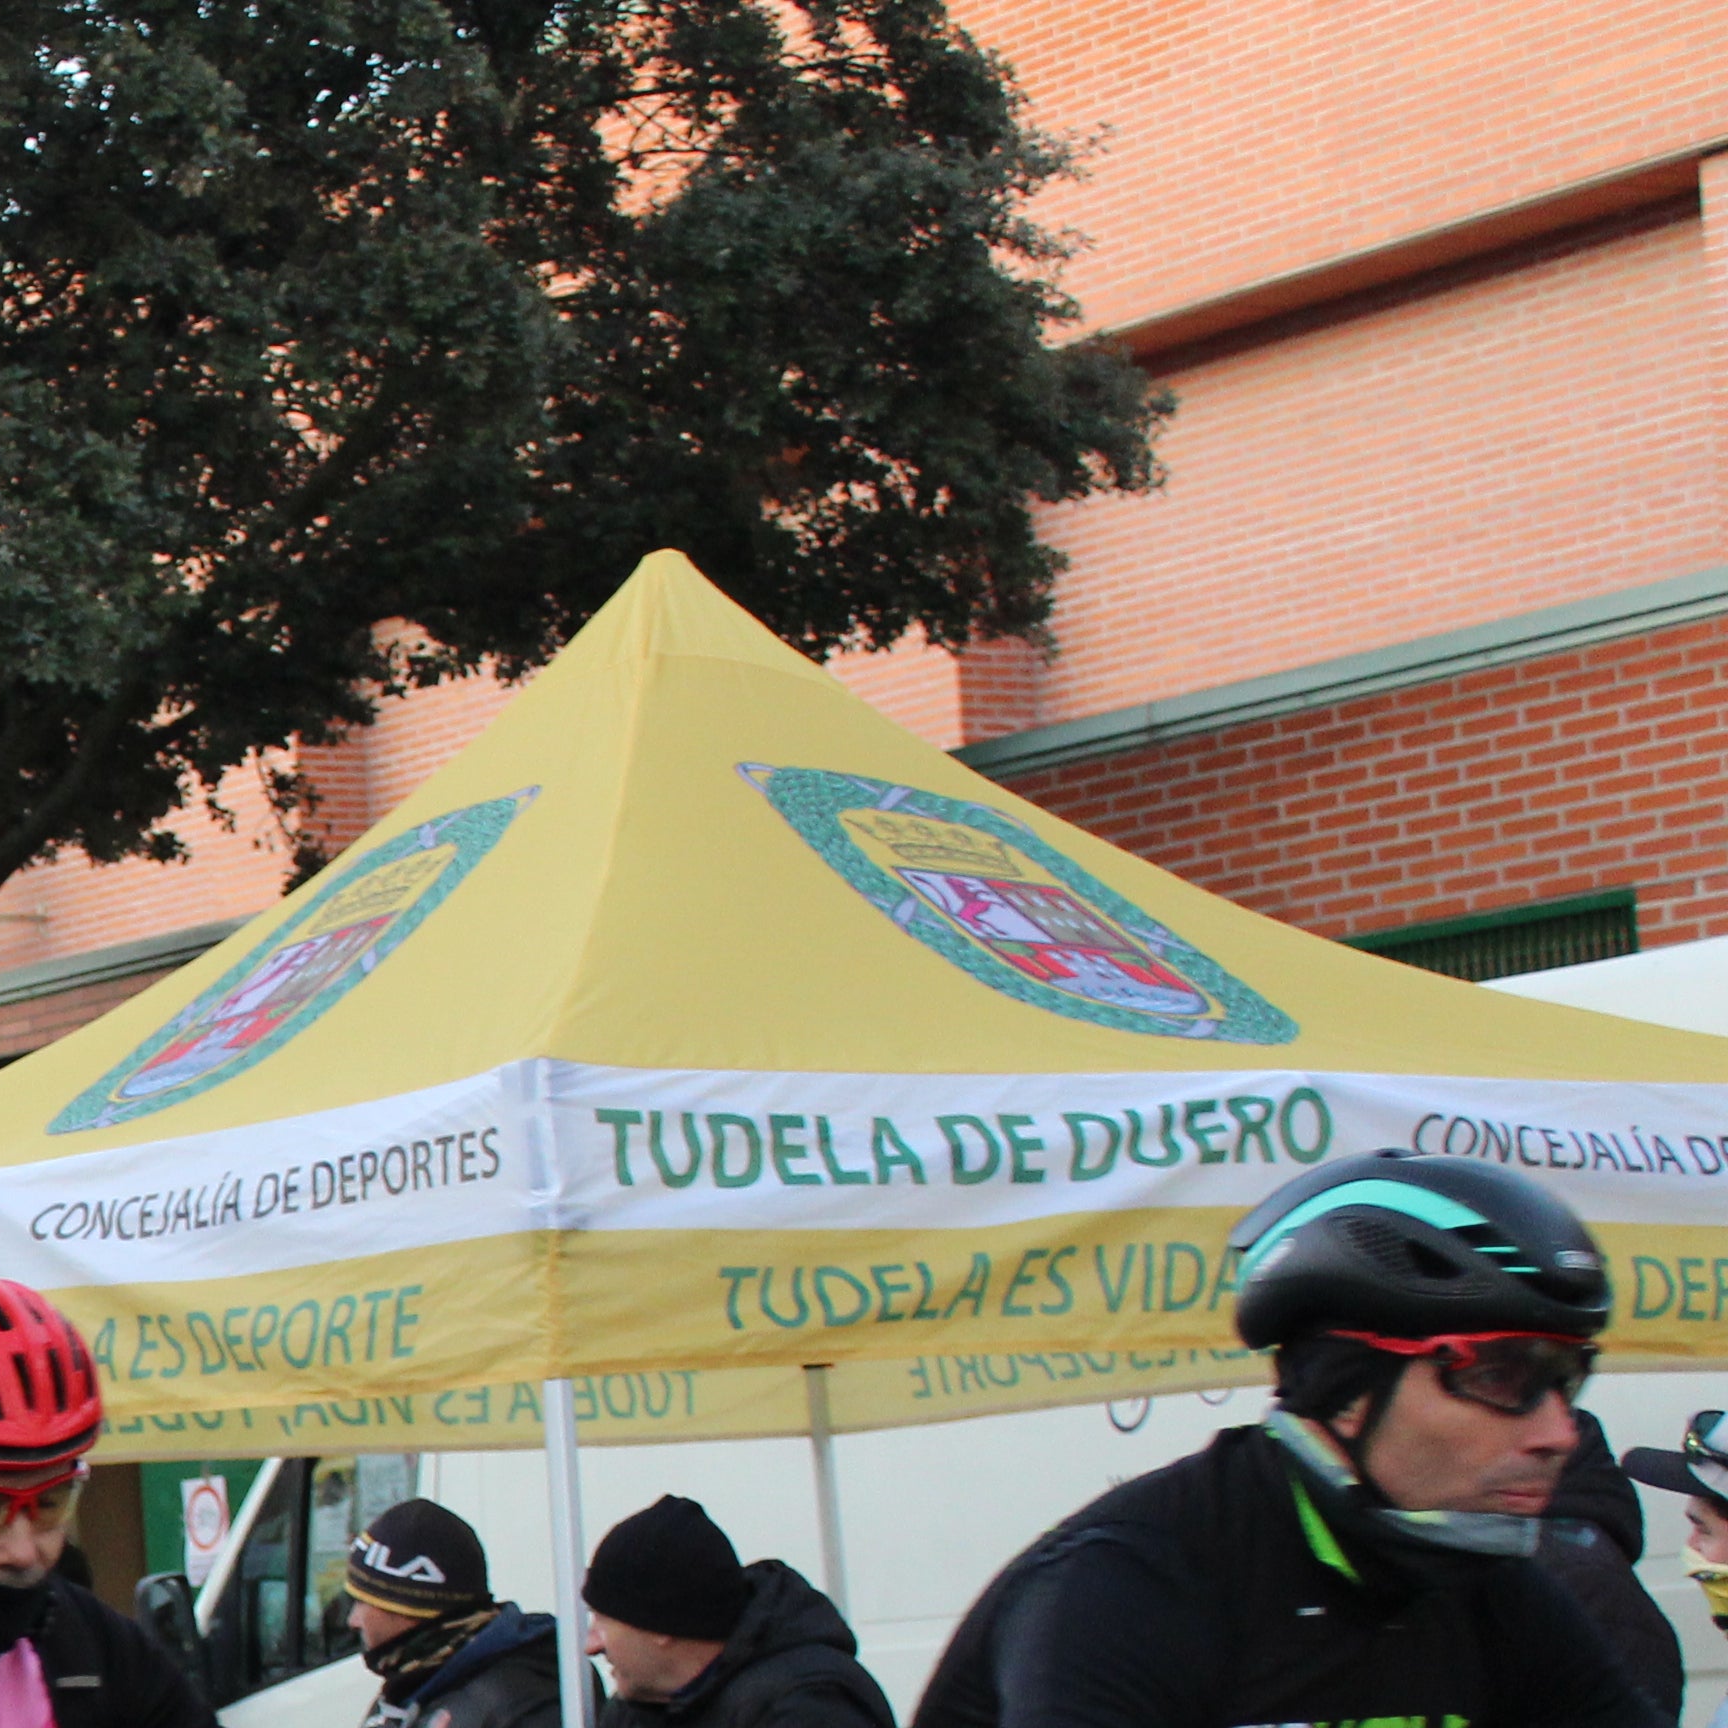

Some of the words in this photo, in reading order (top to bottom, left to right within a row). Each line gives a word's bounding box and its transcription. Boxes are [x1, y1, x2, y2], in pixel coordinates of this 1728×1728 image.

[29, 1171, 242, 1241] CONCEJALÍA
[252, 1164, 300, 1220] DE
[310, 1126, 501, 1209] DEPORTES
[595, 1106, 927, 1189] TUDELA
[935, 1112, 1047, 1187] DE
[1063, 1085, 1332, 1183] DUERO
[1412, 1113, 1686, 1175] CONCEJALÍA
[129, 1311, 187, 1380] ES
[189, 1284, 424, 1374] DEPORTE
[718, 1252, 993, 1331] TUDELA
[999, 1243, 1076, 1318] ES
